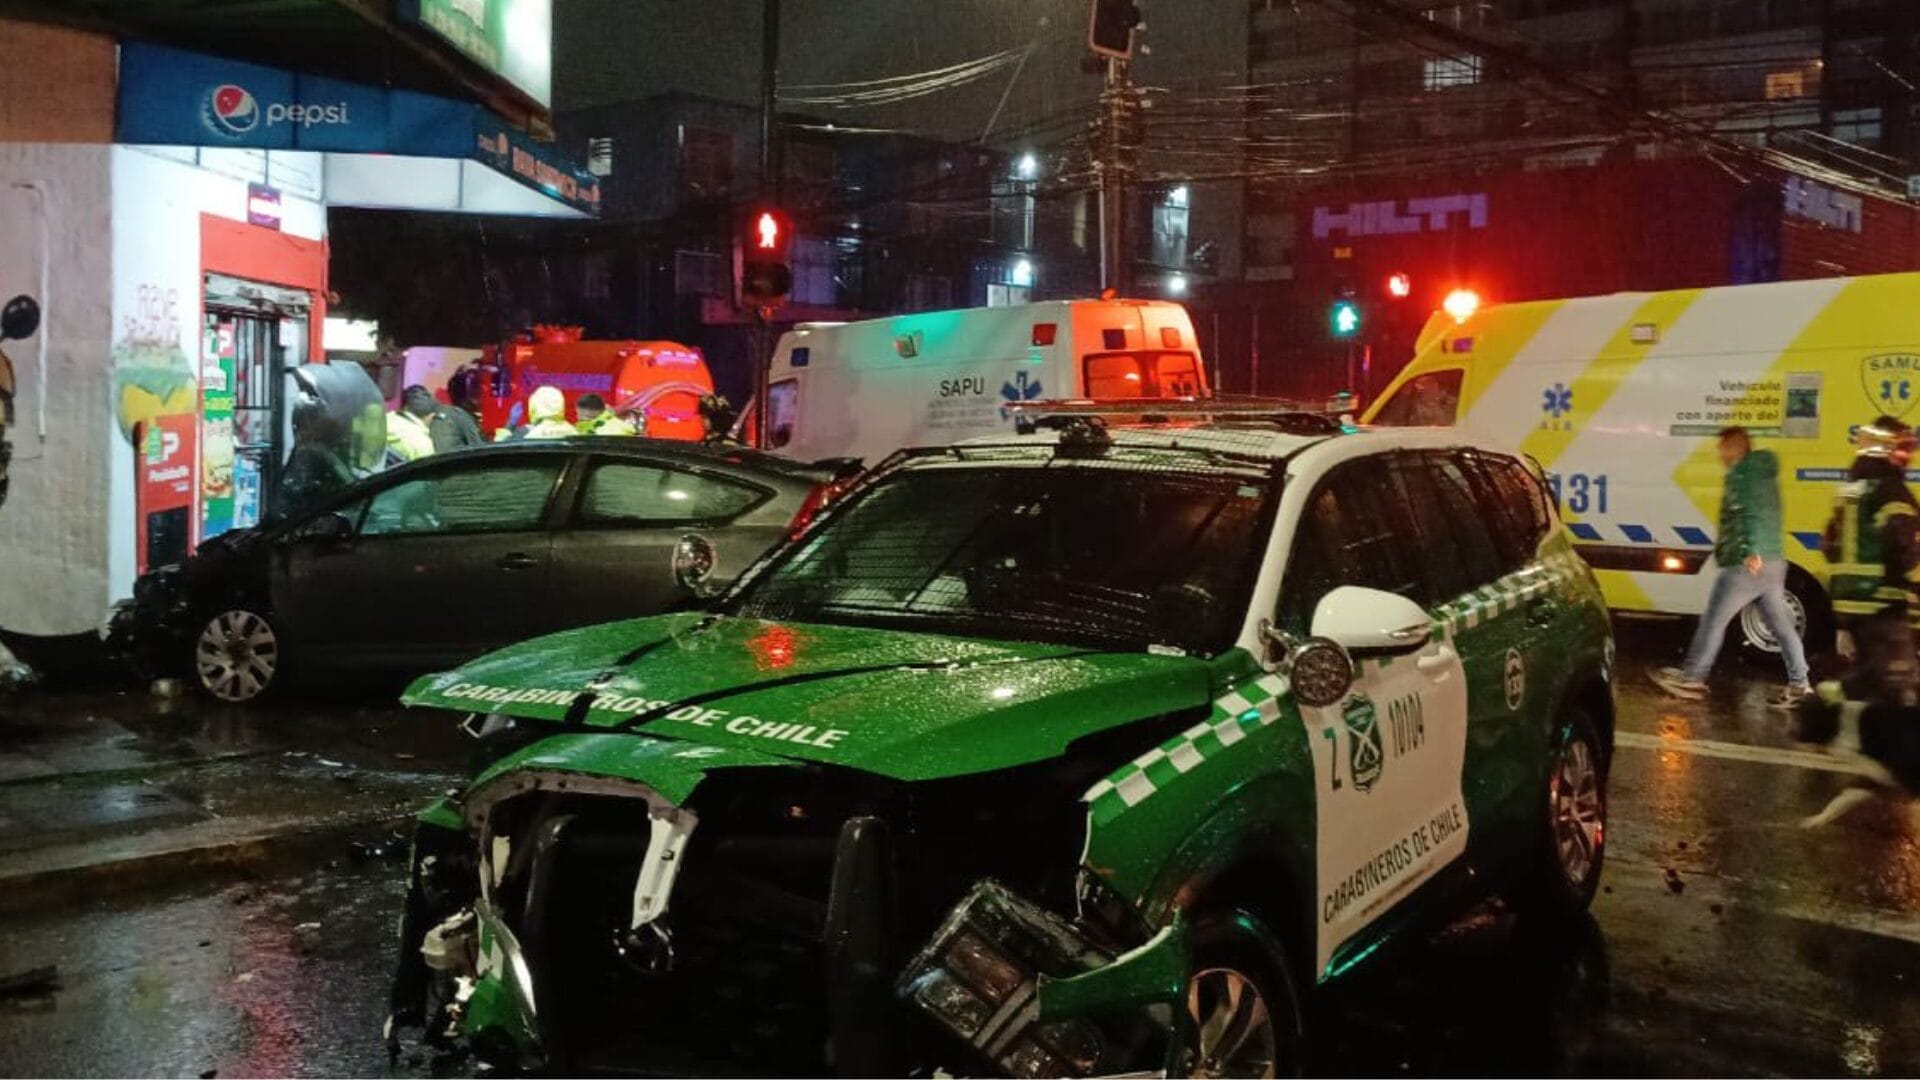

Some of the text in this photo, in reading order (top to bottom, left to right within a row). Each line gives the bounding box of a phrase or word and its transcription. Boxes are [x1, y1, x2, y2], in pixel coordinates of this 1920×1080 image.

[266, 101, 348, 129] pepsi
[1313, 193, 1488, 238] HILTI
[940, 376, 984, 397] SAPU
[1547, 473, 1607, 514] 131
[442, 683, 850, 749] CARABINROS DE CHILE
[1323, 803, 1462, 923] CARABINEROS DE CHILE
